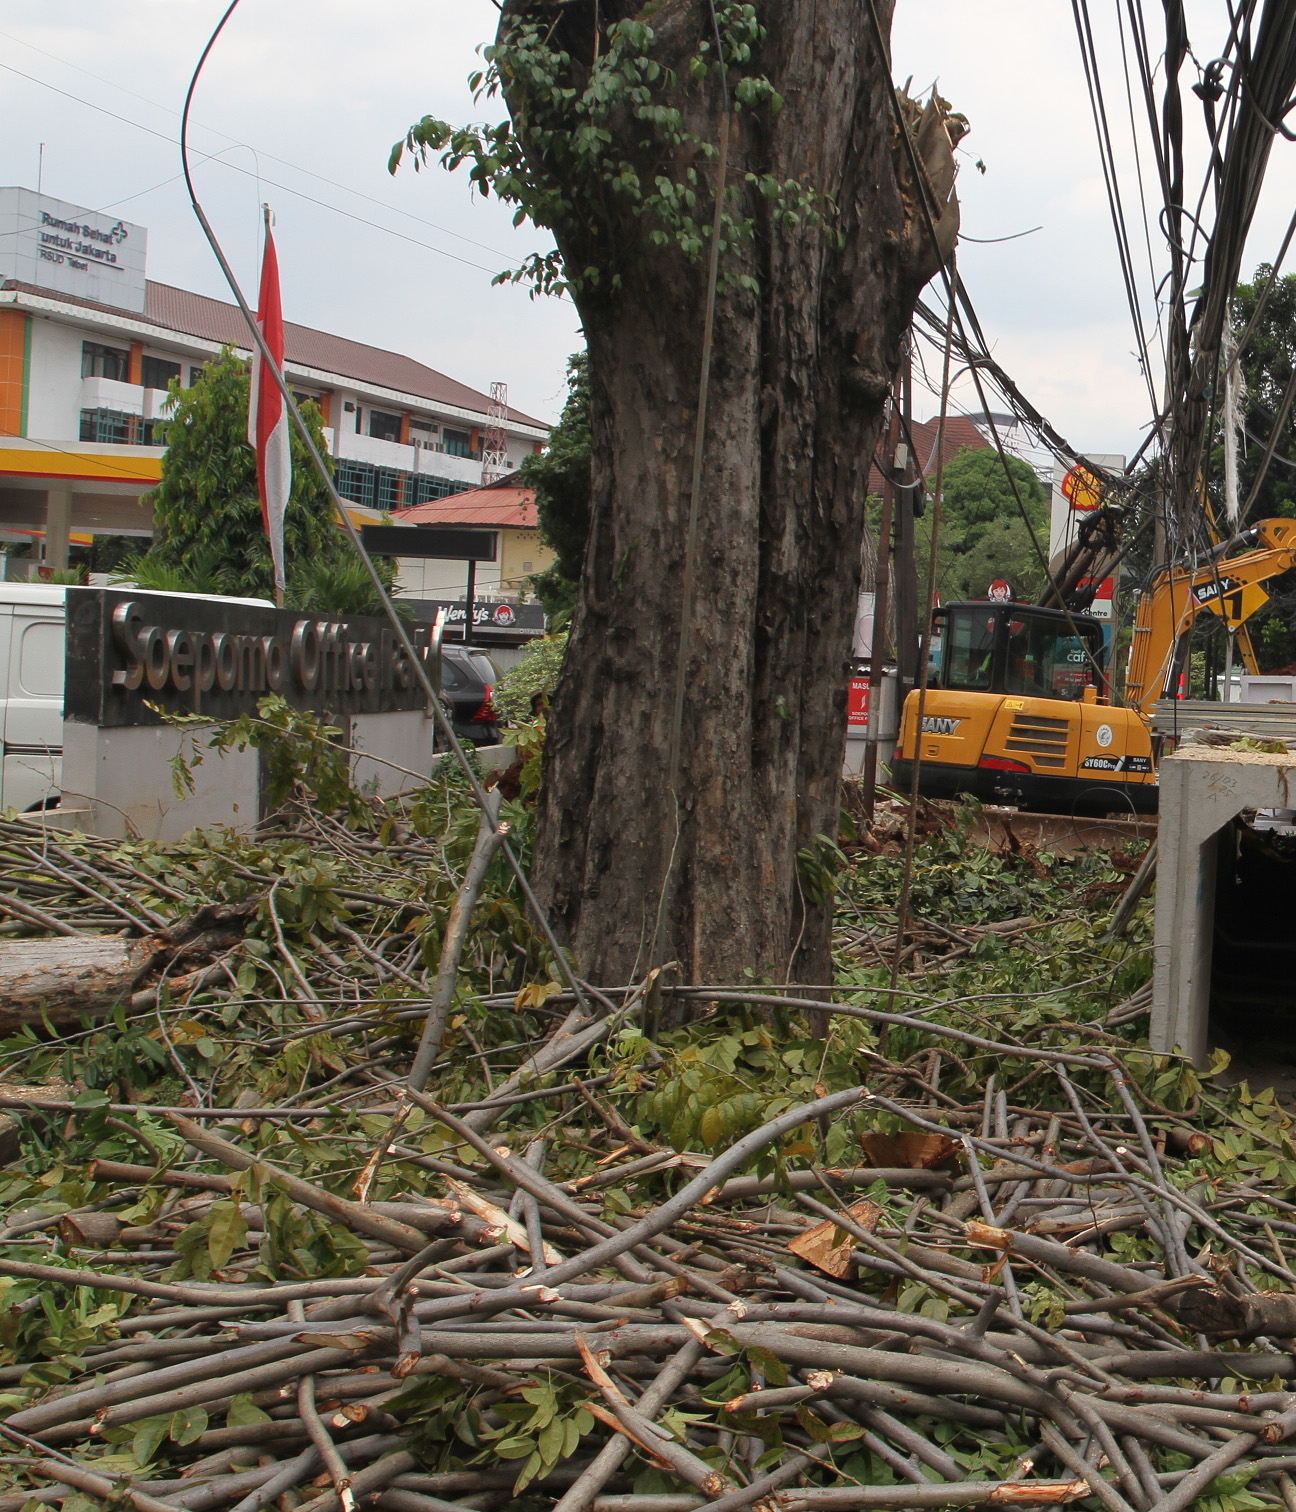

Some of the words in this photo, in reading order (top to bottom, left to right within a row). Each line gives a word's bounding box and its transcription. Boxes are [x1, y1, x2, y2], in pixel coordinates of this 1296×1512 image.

[41, 211, 80, 234] Rumah
[82, 225, 113, 245] Sehat
[40, 249, 64, 264] RSUD
[41, 232, 72, 250] untuk
[75, 241, 117, 263] Jakarta
[438, 604, 489, 625] Weny's
[112, 602, 281, 714] Soepomo
[291, 620, 377, 690] Office
[1066, 650, 1088, 663] caf
